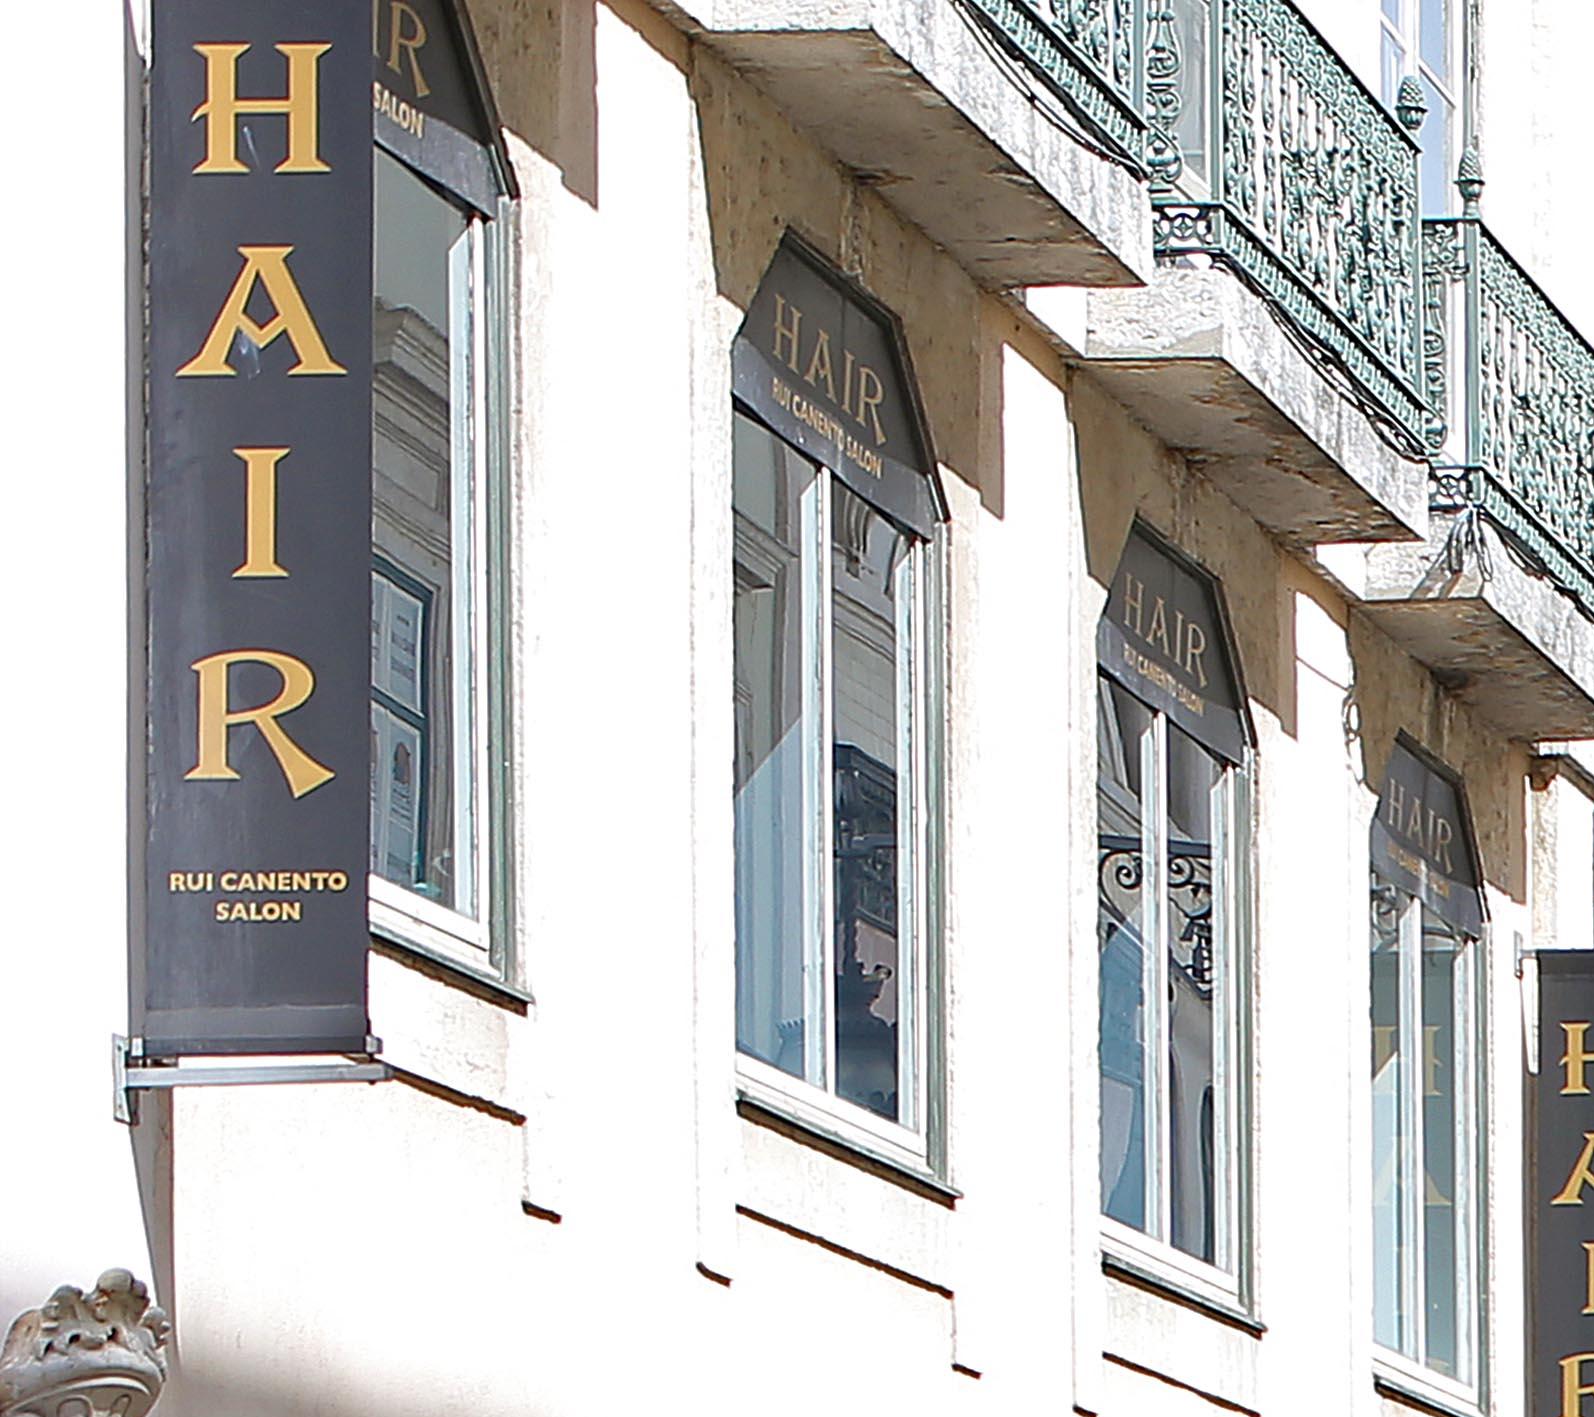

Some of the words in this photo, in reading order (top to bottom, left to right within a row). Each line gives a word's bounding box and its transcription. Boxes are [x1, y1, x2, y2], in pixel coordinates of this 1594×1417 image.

[772, 292, 886, 445] HAIR
[772, 377, 791, 411] RUI
[175, 42, 347, 799] HAIR
[1124, 572, 1207, 688] HAIR
[1388, 778, 1453, 874] HAIR
[170, 872, 213, 890] RUI
[221, 871, 348, 890] CANENTO
[215, 902, 302, 921] SALON
